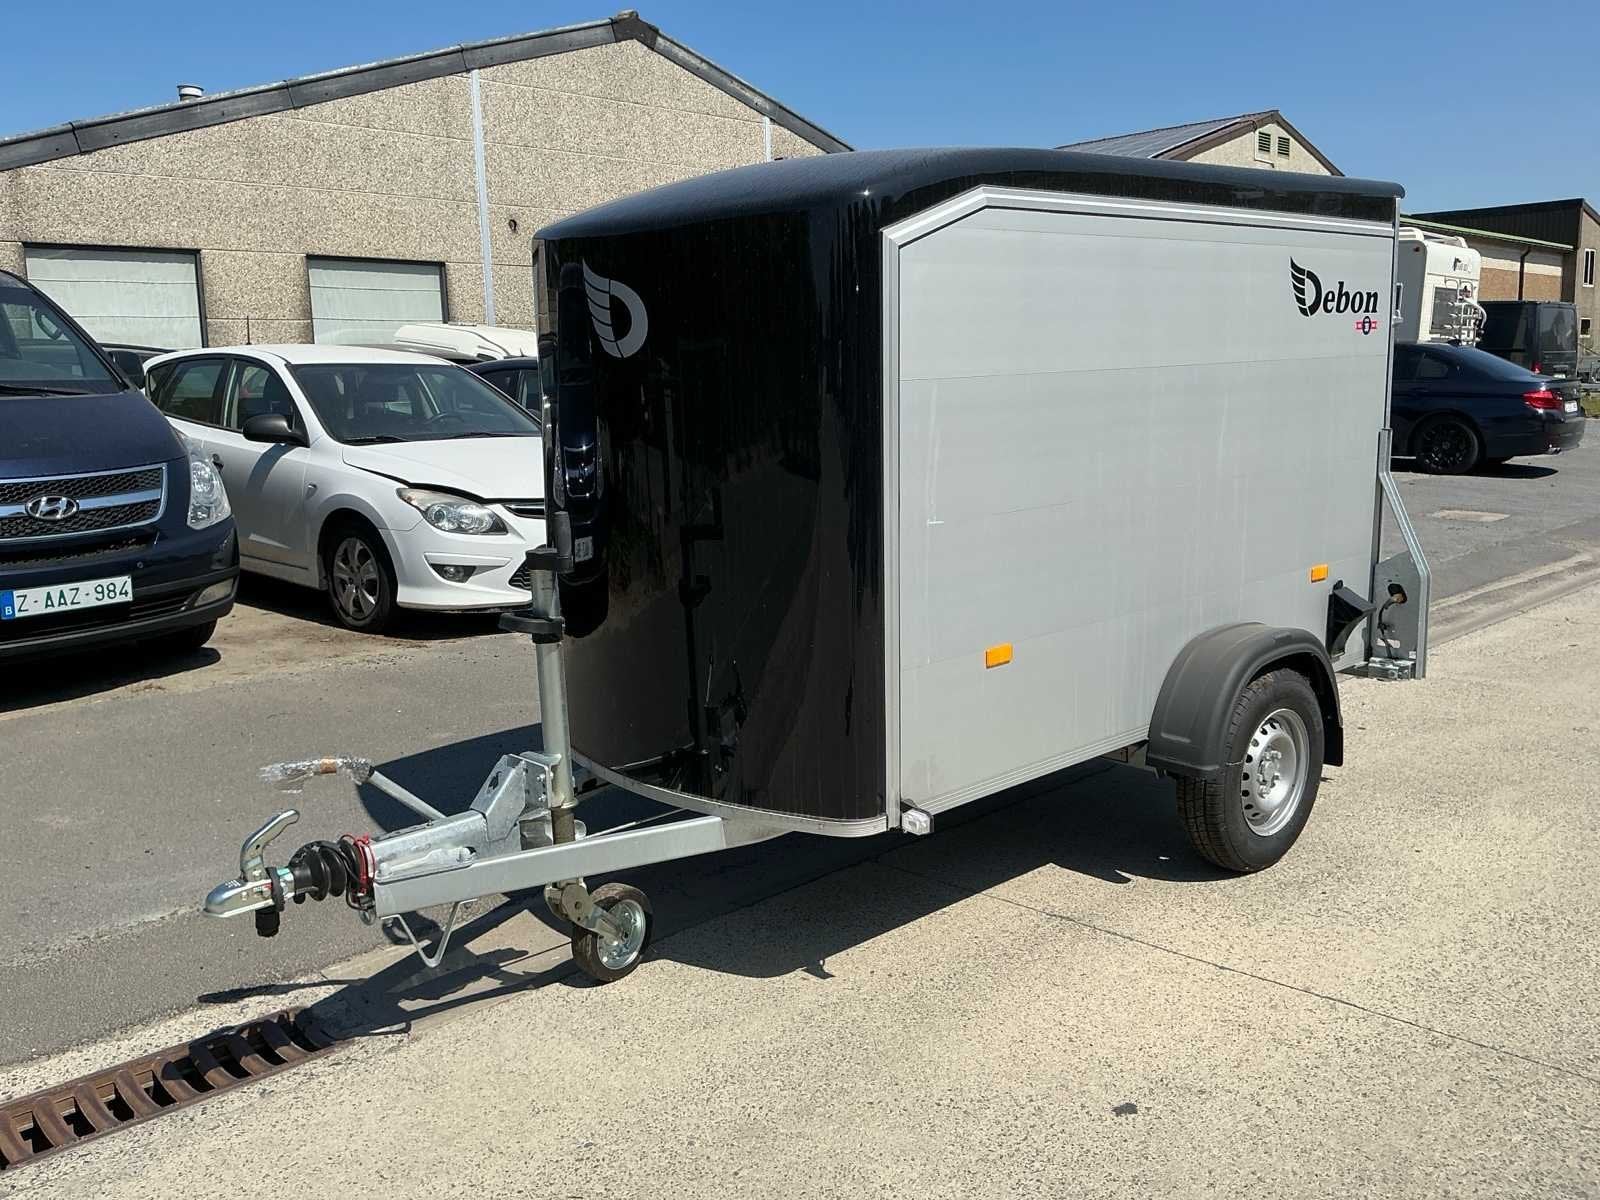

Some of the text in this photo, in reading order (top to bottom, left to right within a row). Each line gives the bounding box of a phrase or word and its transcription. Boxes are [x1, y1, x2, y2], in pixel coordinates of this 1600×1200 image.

[1289, 255, 1378, 317] Debon
[5, 606, 13, 615] B
[15, 580, 130, 613] Z-AAZ-984
